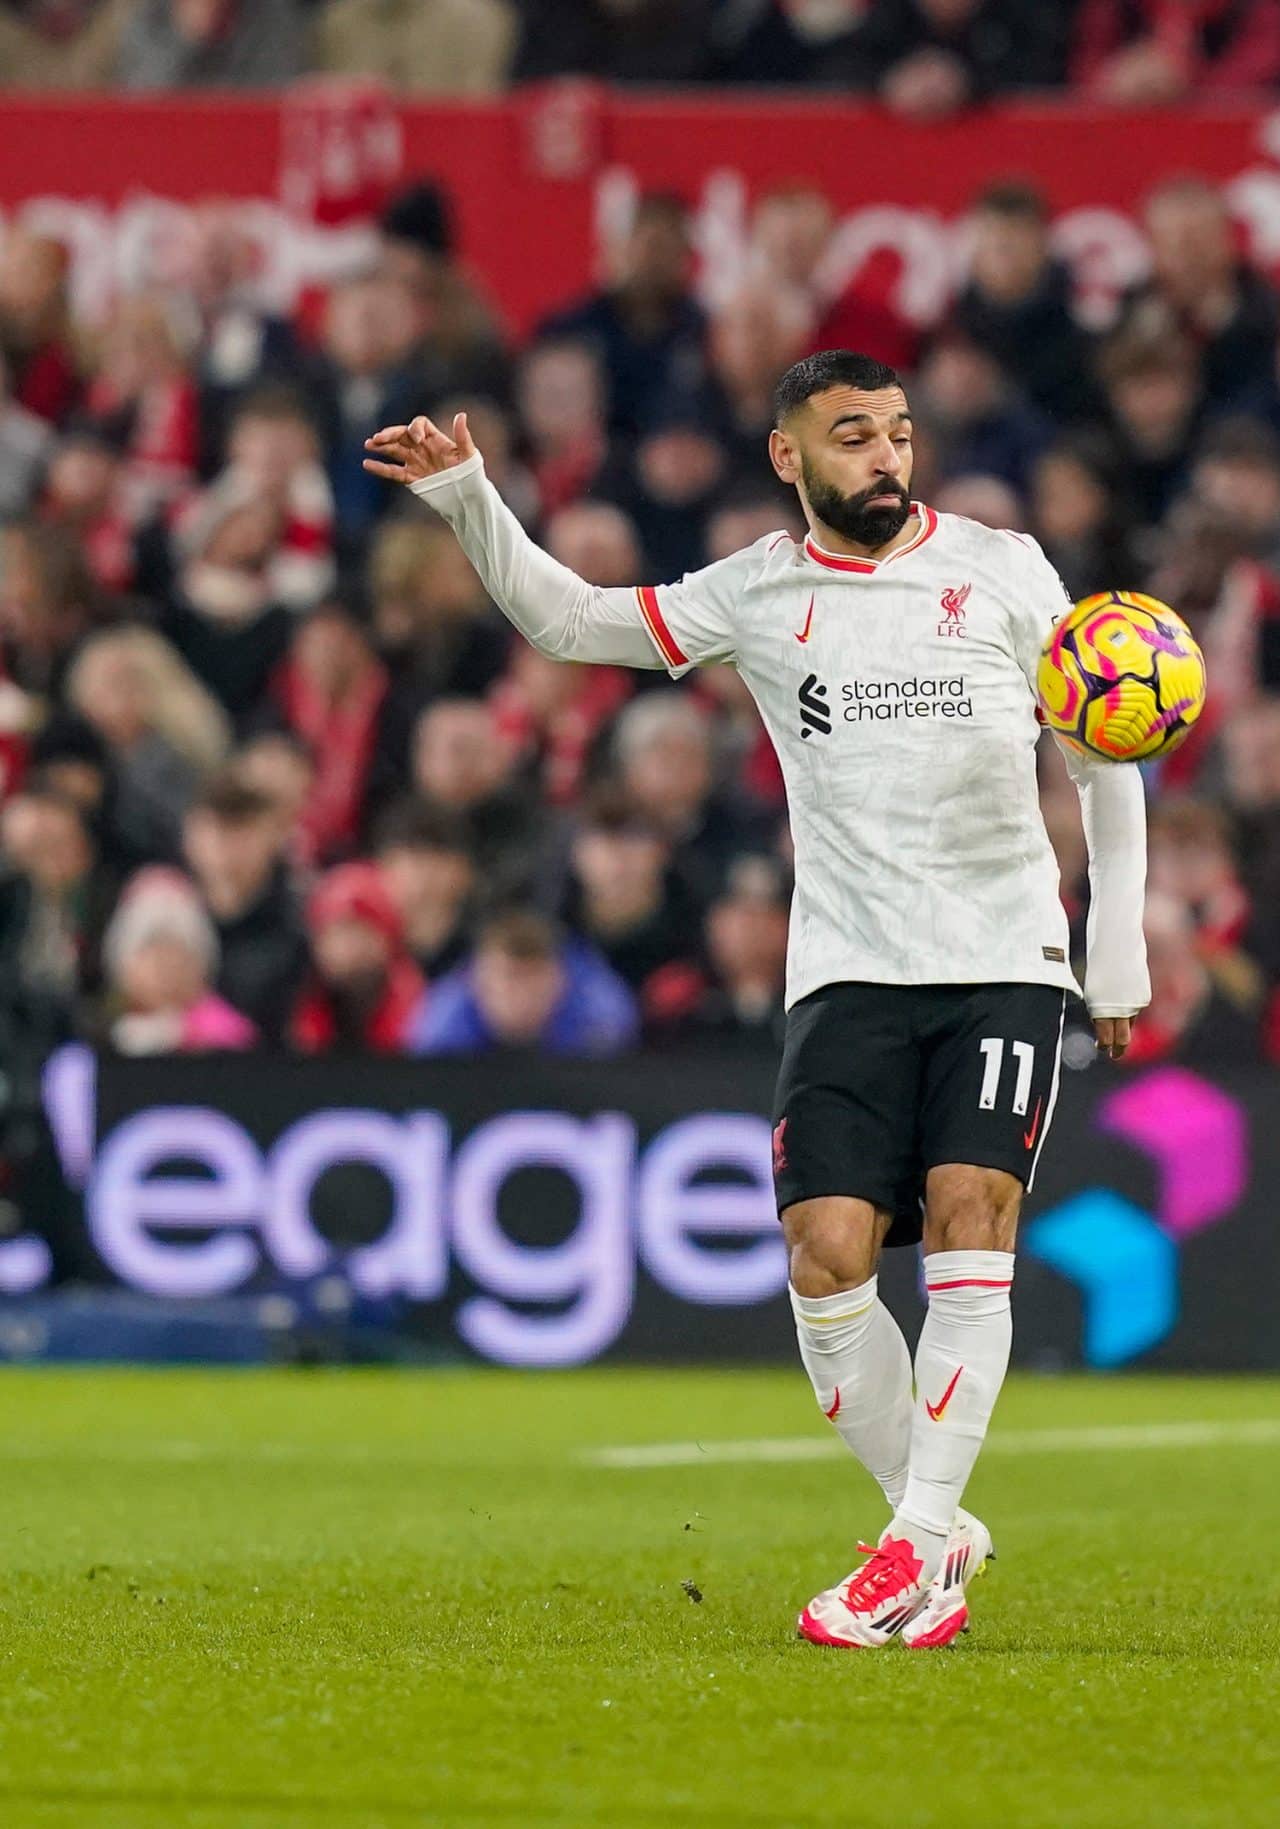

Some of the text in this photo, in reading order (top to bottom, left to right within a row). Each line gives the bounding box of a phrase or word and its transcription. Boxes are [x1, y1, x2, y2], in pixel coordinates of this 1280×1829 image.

[841, 677, 964, 701] standard
[843, 698, 973, 722] chartered
[979, 1037, 1035, 1117] 11
